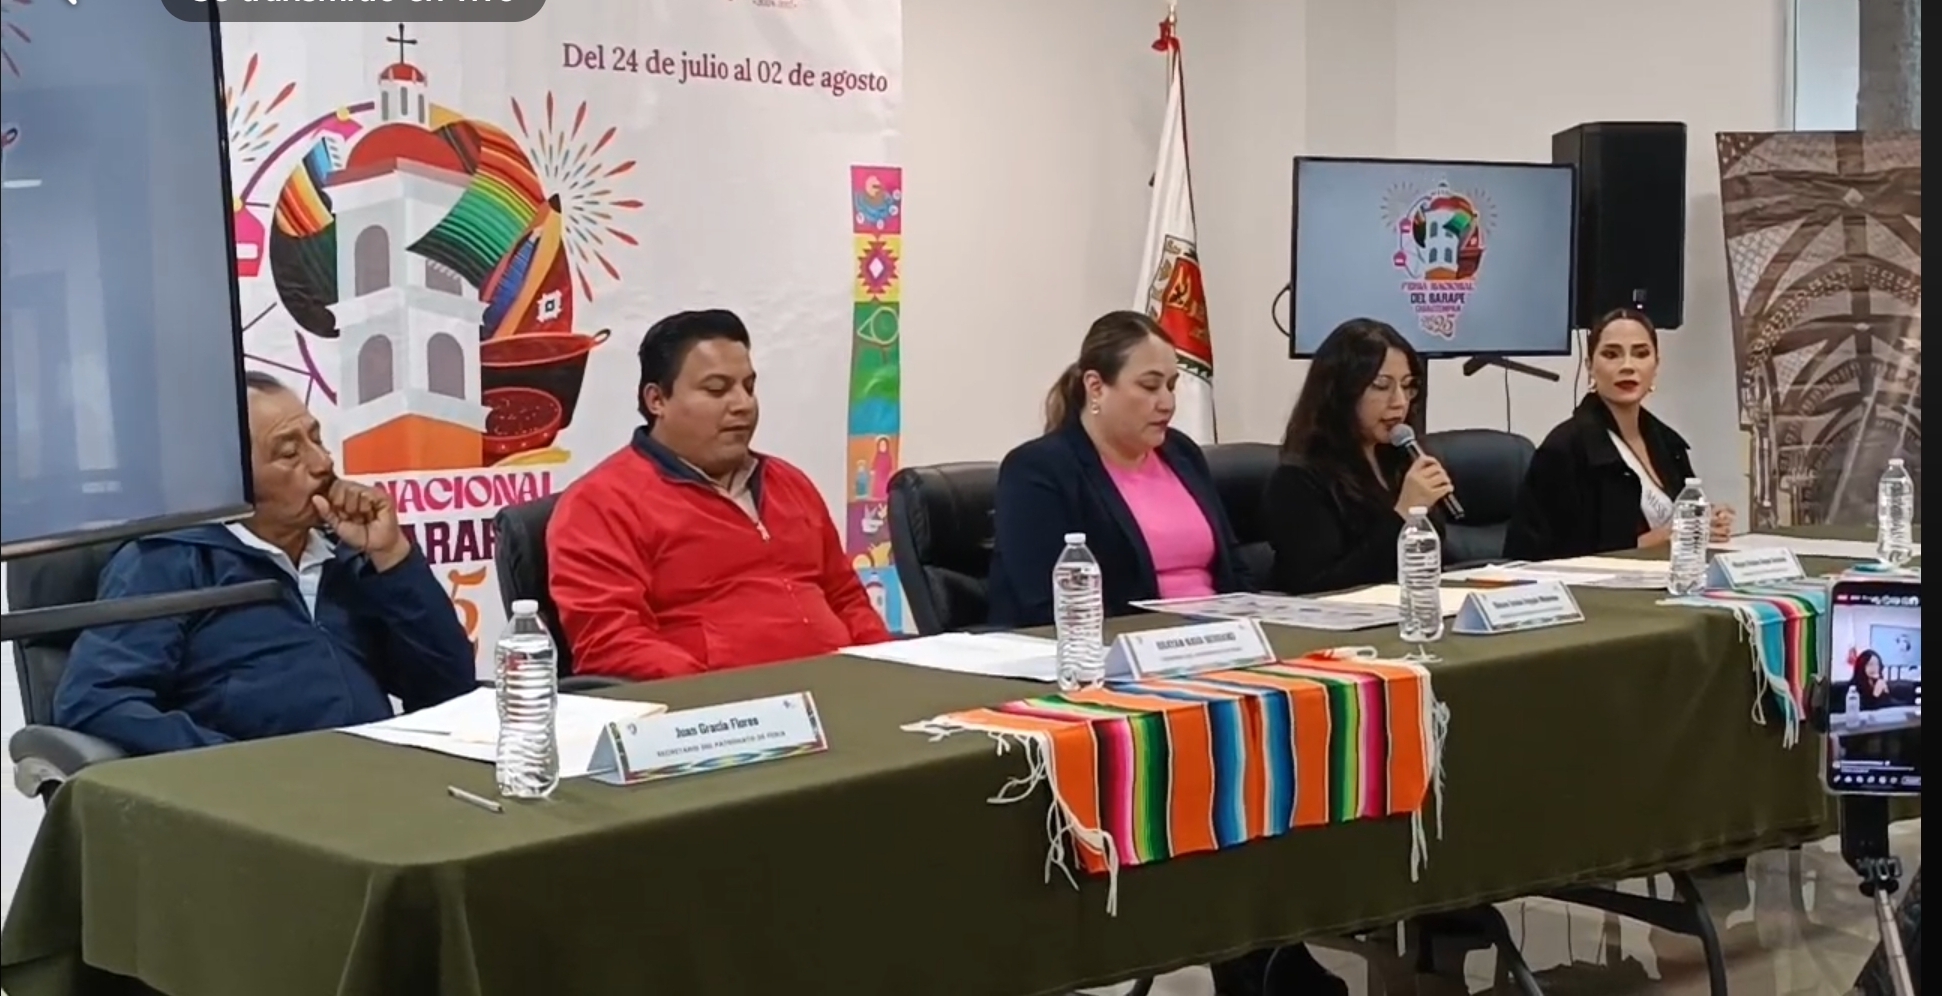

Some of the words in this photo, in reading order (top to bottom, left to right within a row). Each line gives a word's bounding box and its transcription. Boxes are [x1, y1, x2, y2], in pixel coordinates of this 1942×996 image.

[562, 42, 605, 70] Del
[612, 46, 639, 73] 24
[645, 49, 675, 76] de
[678, 50, 729, 84] julio
[733, 57, 752, 82] al
[757, 60, 782, 84] 02
[788, 62, 815, 87] de
[820, 70, 888, 97] agosto
[675, 726, 698, 738] Juan
[730, 717, 759, 729] Flores
